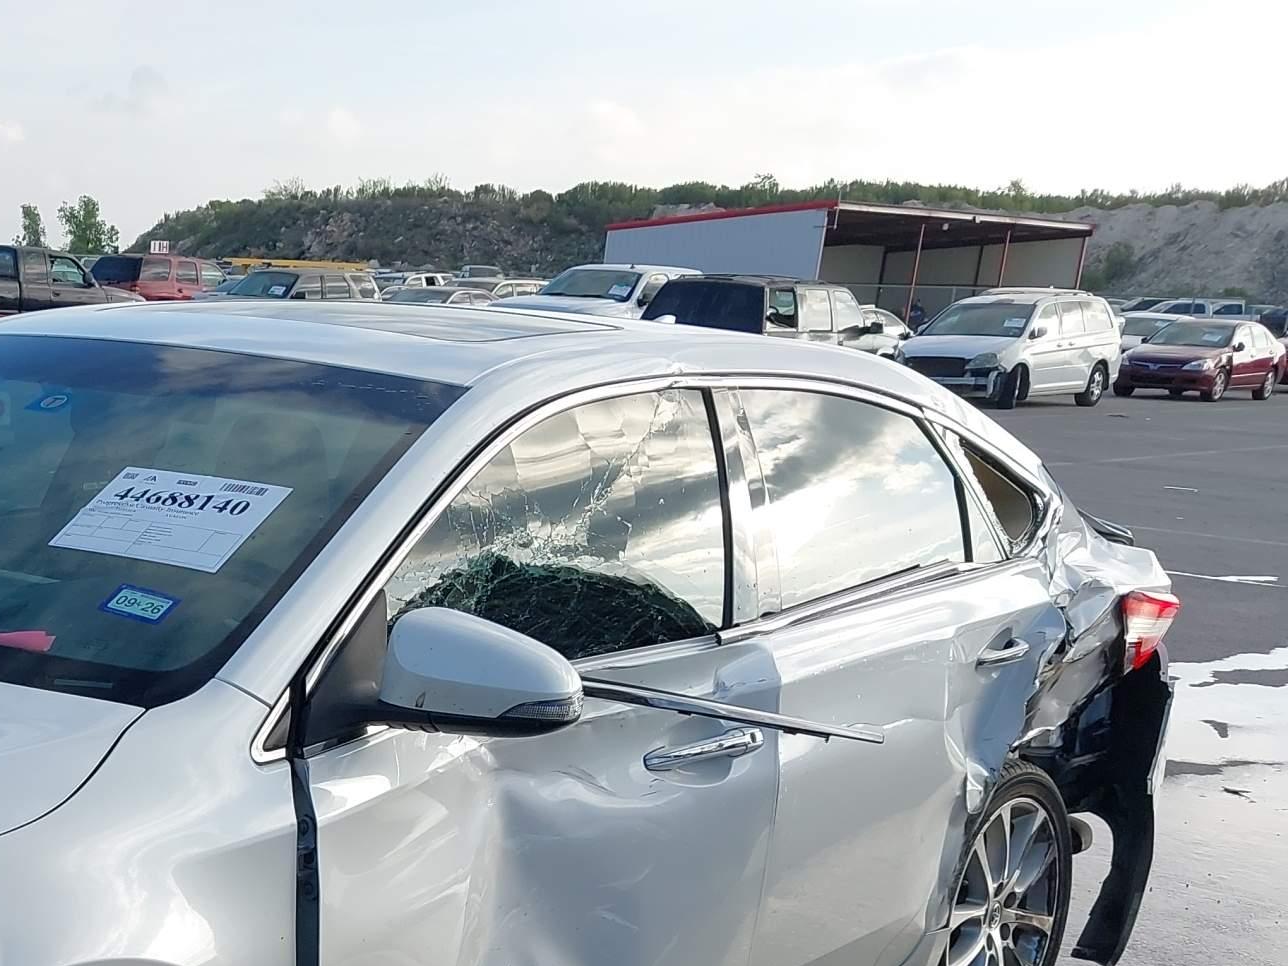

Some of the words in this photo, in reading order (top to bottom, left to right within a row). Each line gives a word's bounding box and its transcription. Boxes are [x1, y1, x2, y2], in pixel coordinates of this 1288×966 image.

[114, 486, 251, 516] 44688140
[115, 595, 138, 608] 09
[141, 601, 164, 615] 26
